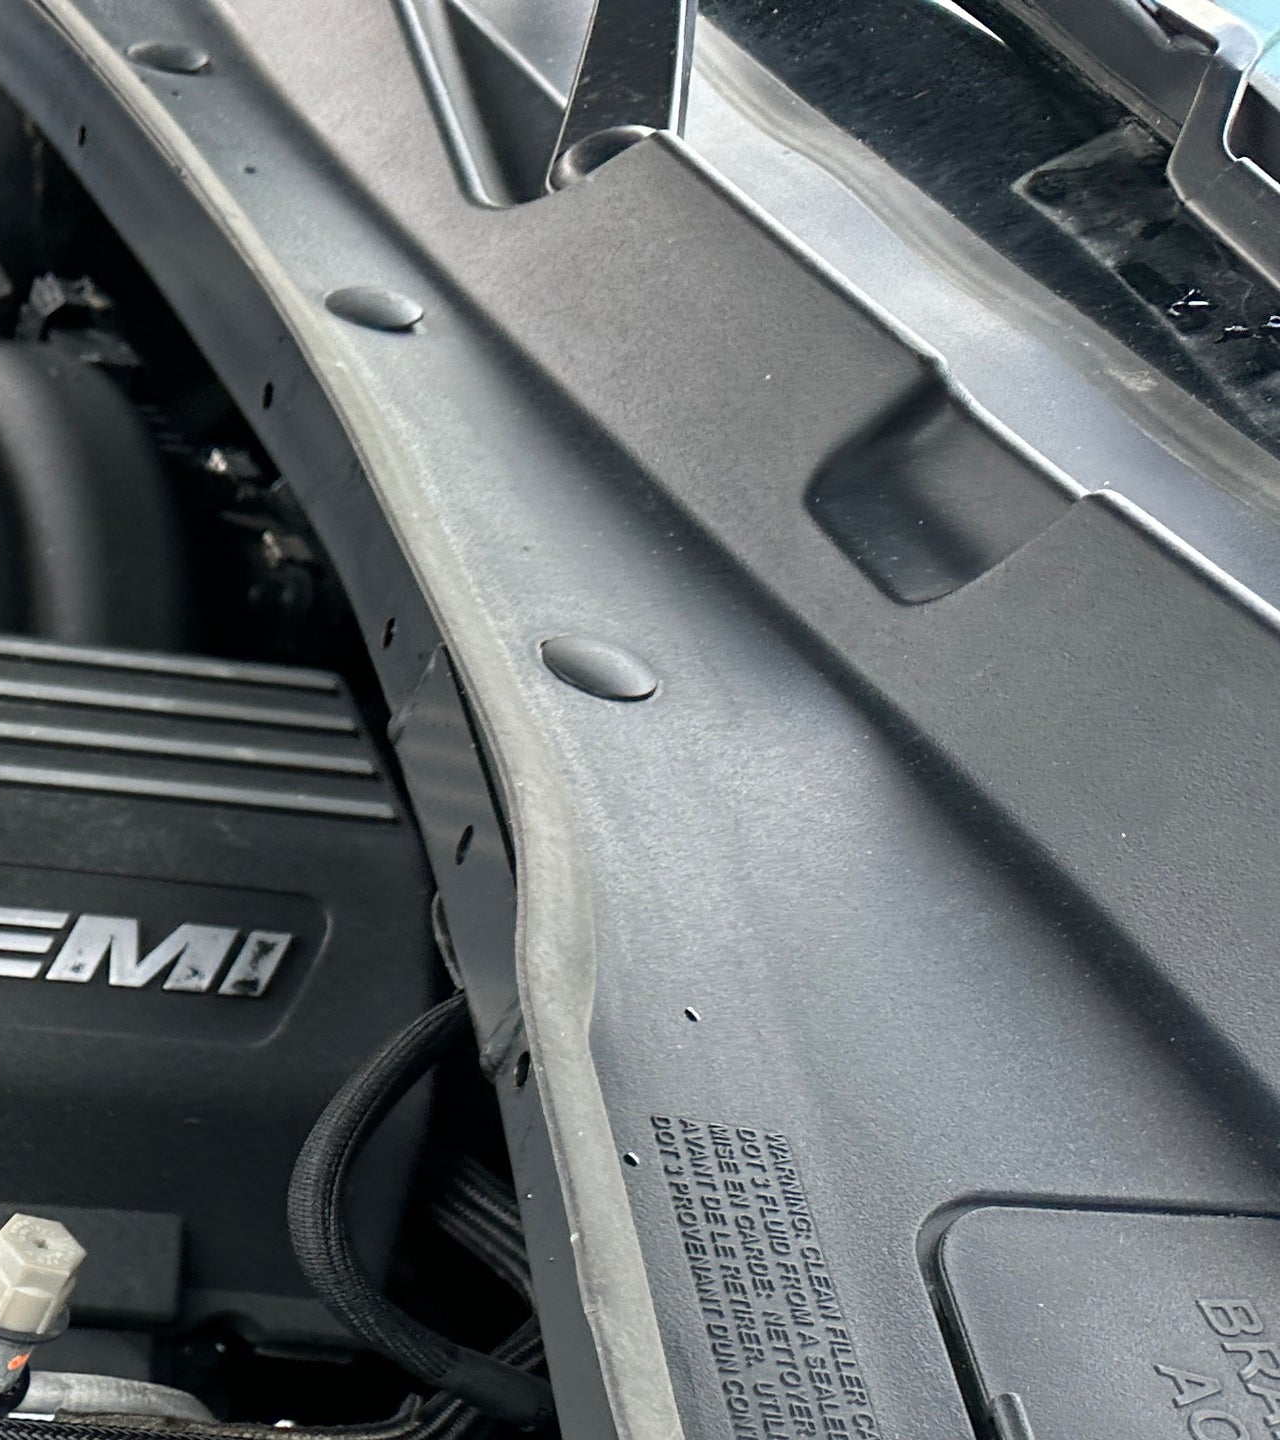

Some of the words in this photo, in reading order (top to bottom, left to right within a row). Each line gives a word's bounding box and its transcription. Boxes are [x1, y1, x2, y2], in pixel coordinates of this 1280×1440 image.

[650, 1114, 682, 1161] DOT
[678, 1118, 718, 1192] AVANT
[708, 1122, 740, 1175] MISE
[736, 1127, 767, 1173] DOT
[663, 1163, 685, 1177] 3
[724, 1178, 751, 1209] EN
[750, 1176, 771, 1189] 3
[700, 1195, 728, 1227] DE
[755, 1193, 793, 1257] FLUID
[668, 1180, 725, 1319] PROVENANT
[710, 1230, 738, 1260] LE
[734, 1214, 776, 1300] GARDE:
[765, 1131, 813, 1240] WARNING:
[800, 1246, 843, 1320] CLEAN
[825, 1326, 867, 1407] FILLER
[775, 1261, 816, 1327] FROM
[796, 1330, 822, 1348] A
[761, 1310, 817, 1437] NETTOYER
